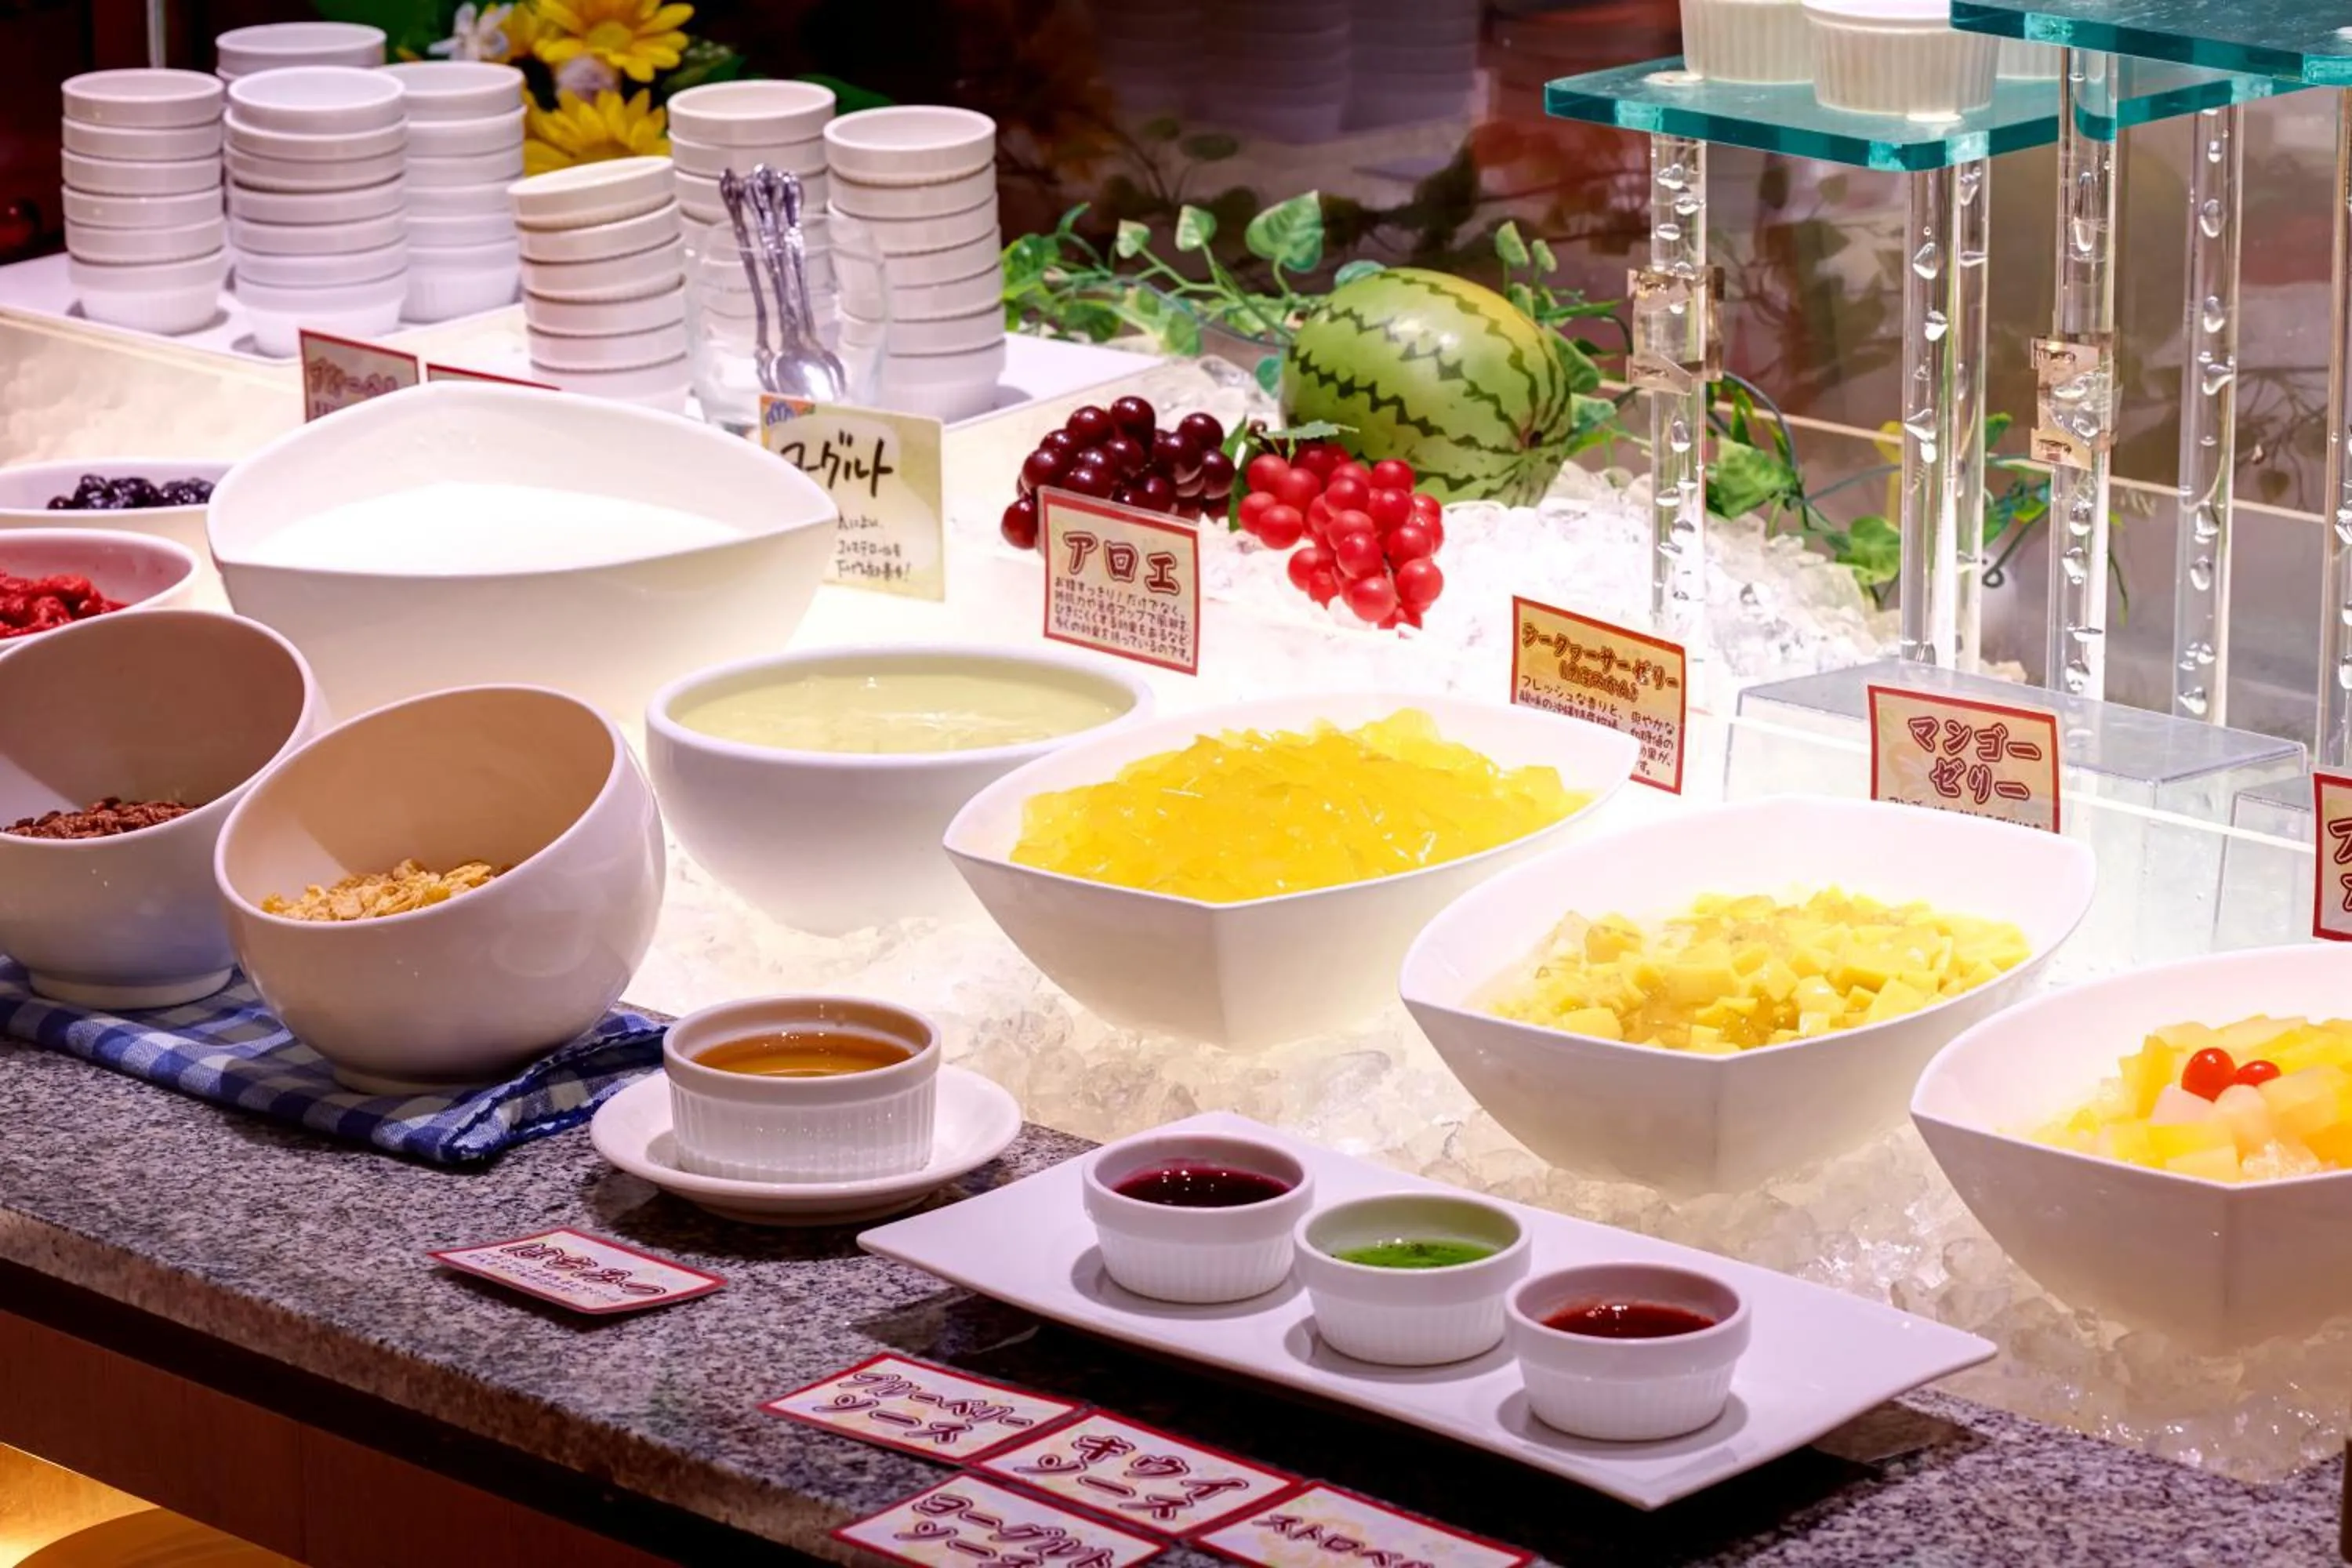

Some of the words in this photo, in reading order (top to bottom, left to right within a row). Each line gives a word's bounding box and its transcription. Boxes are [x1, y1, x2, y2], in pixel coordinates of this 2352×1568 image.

[1062, 531, 1181, 596] アロエ
[1907, 716, 2042, 762] マンゴー
[1929, 757, 2030, 804] ゼリー
[812, 1394, 974, 1444] ソース
[837, 1373, 1034, 1428] ブルーベリー
[1014, 1454, 1195, 1520] ソース
[1071, 1434, 1250, 1501] キウイ
